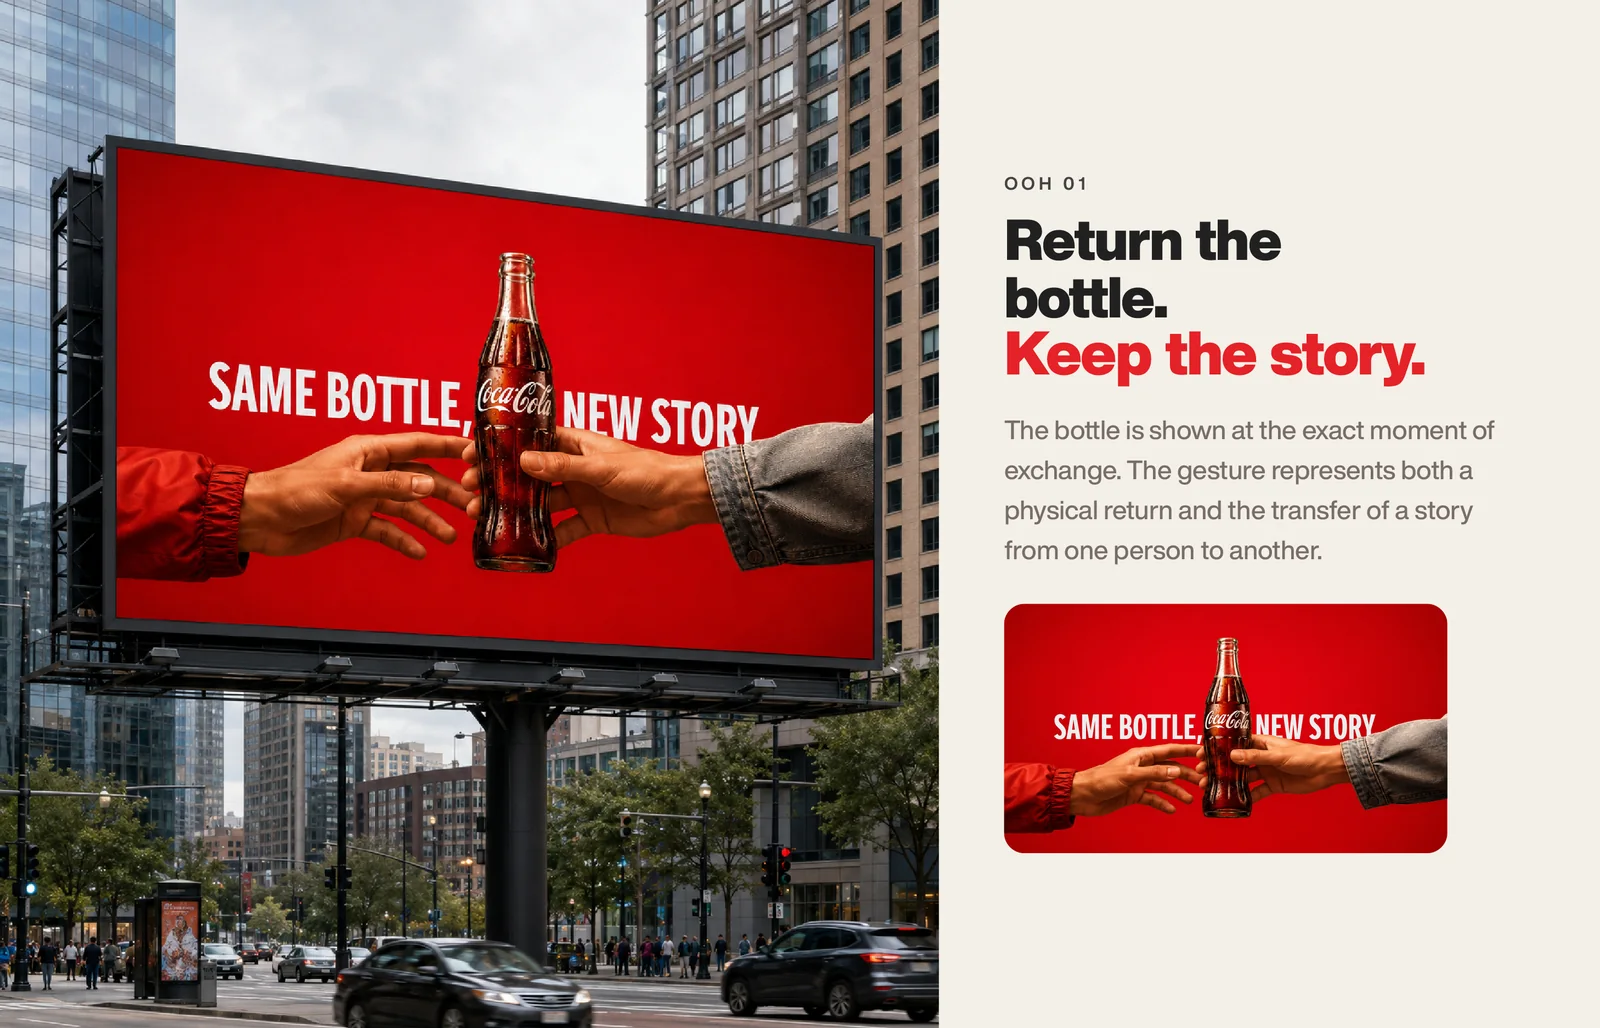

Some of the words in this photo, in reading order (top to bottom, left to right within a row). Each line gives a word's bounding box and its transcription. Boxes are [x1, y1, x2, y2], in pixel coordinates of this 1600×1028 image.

[208, 361, 317, 417] SAME
[327, 371, 473, 437] BOTTLE,
[563, 390, 642, 441] NEW
[650, 397, 760, 447] STORY
[477, 378, 553, 416] Coca-Cola
[1053, 713, 1113, 740] SAME
[1119, 713, 1203, 745] BOTTLE,
[1256, 713, 1304, 740] NEW
[1309, 713, 1377, 740] STORY
[1204, 710, 1250, 730] Coca-Cola
